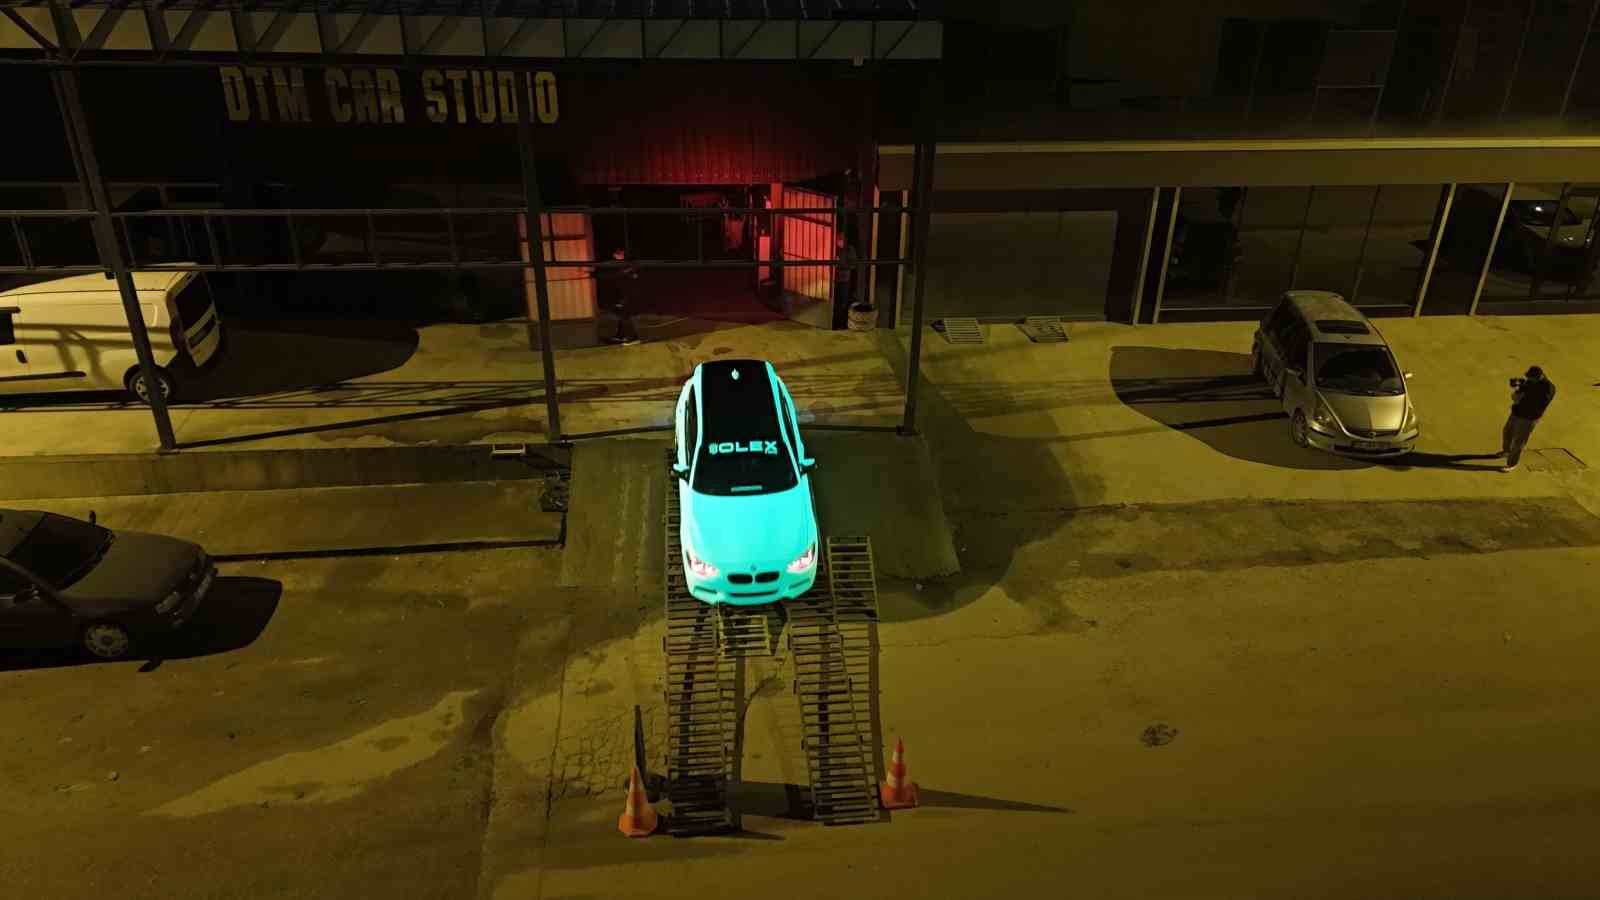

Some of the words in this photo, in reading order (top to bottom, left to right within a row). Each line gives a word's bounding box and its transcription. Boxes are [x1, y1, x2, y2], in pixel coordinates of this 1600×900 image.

[218, 66, 312, 121] DTM
[324, 66, 406, 123] CAR
[421, 69, 559, 124] STUDIO
